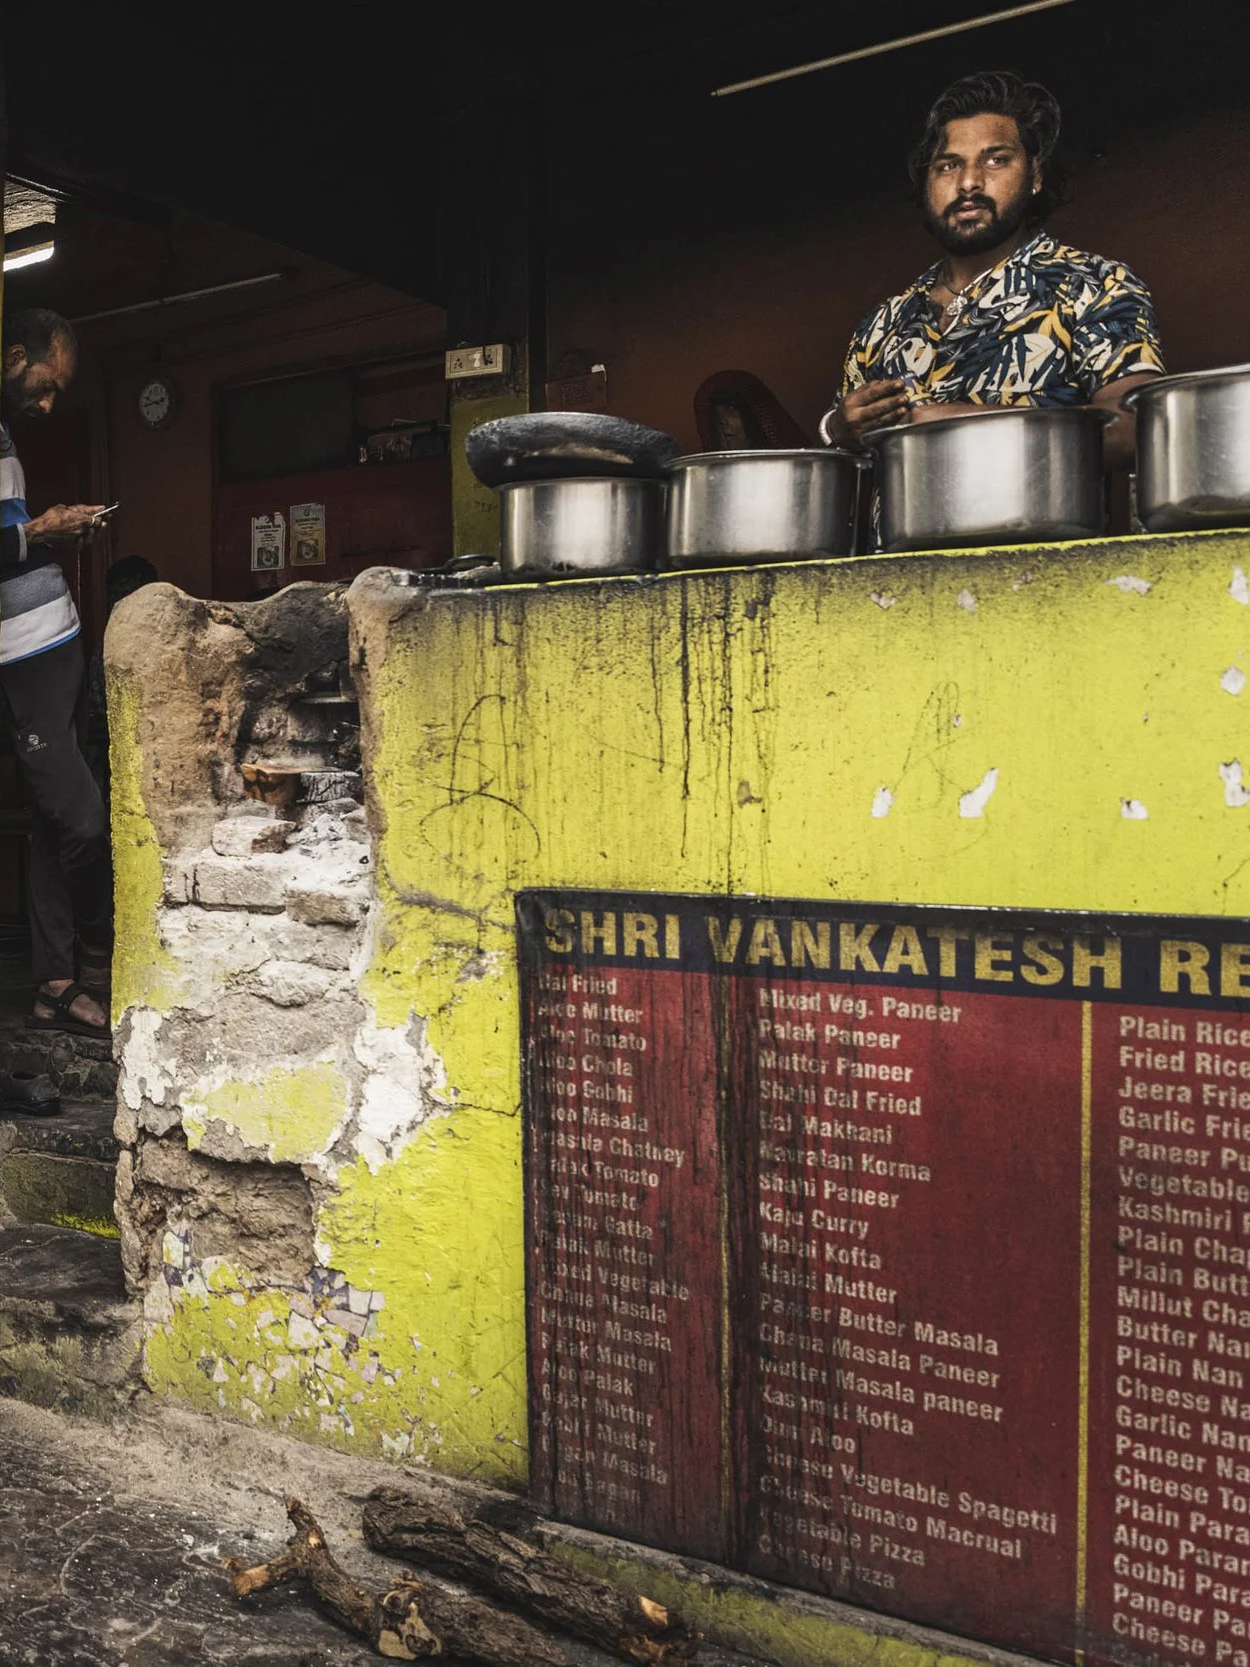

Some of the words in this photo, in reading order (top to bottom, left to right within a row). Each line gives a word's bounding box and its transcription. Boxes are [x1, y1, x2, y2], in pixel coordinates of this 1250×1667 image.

[544, 908, 680, 960] SHRI
[704, 914, 1123, 990] VANKATESH
[1159, 938, 1250, 999] RE
[572, 974, 617, 995] Fried
[582, 1001, 643, 1023] Mutter
[759, 987, 821, 1013] Mixed
[829, 993, 874, 1020] Veg.
[882, 995, 962, 1024] Paneer
[583, 1028, 647, 1051] Tomato
[759, 1018, 816, 1042] Palak
[825, 1024, 901, 1050] Paneer
[1119, 1015, 1186, 1042] Plain
[1196, 1020, 1250, 1048] Rice
[582, 1054, 633, 1077] Chola
[759, 1049, 830, 1075] Mutter
[836, 1057, 914, 1084] Paneer
[1119, 1045, 1185, 1073] Fried
[1195, 1051, 1250, 1079] Rice
[583, 1080, 633, 1103] Gobhi
[759, 1080, 816, 1105] Shahi
[824, 1087, 858, 1110] Dal
[866, 1090, 922, 1117] Fried
[1118, 1076, 1192, 1104] Jeera
[1202, 1083, 1250, 1111] Frie
[583, 1106, 648, 1133] Masala
[804, 1115, 893, 1145] Makhani
[1118, 1105, 1195, 1135] Garlic
[542, 1131, 603, 1153] asala
[610, 1137, 685, 1168] Chatney
[1118, 1135, 1211, 1168] Paneer
[1221, 1147, 1250, 1172] Pu
[594, 1161, 659, 1188] Tomato
[861, 1152, 931, 1183] Korma
[1118, 1165, 1250, 1204] Vegetable
[577, 1185, 639, 1211] Tomato
[759, 1171, 816, 1198] Shahi
[824, 1180, 900, 1209] Paneer
[605, 1216, 652, 1240] Gatta
[760, 1201, 804, 1228] Kaju
[812, 1209, 869, 1240] Curry
[1118, 1195, 1232, 1232] Kashmiri
[594, 1239, 655, 1266] Mutter
[760, 1232, 817, 1260] Malai
[825, 1241, 882, 1271] Kofta
[1118, 1225, 1183, 1256] Plain
[1194, 1236, 1250, 1272] Cha
[598, 1267, 690, 1301] Vegetable
[825, 1272, 897, 1304] Mutter
[1118, 1254, 1183, 1286] Plain
[1194, 1267, 1250, 1298] Butt
[602, 1294, 667, 1324] Masala
[1117, 1285, 1193, 1319] Millut
[1202, 1299, 1250, 1329] Cha
[605, 1320, 672, 1352] Masala
[839, 1306, 905, 1338] Butter
[914, 1320, 999, 1357] Masala
[1117, 1315, 1198, 1349] Butter
[597, 1344, 657, 1374] Mutter
[760, 1323, 823, 1353] Chana
[833, 1336, 911, 1371] Masala
[919, 1353, 1000, 1389] Paneer
[1117, 1345, 1182, 1378] Plain
[1192, 1357, 1244, 1390] Nan
[584, 1369, 634, 1397] Palak
[760, 1356, 828, 1385] Mutter
[836, 1369, 915, 1404] Masala
[923, 1389, 1003, 1423] paneer
[1116, 1374, 1210, 1413] Cheese
[1221, 1395, 1250, 1421] Na
[595, 1397, 654, 1428] Mutter
[856, 1405, 914, 1436] Kofta
[1116, 1404, 1192, 1441] Garlic
[1202, 1420, 1250, 1452] Nan
[597, 1423, 657, 1455] Mutter
[603, 1450, 668, 1485] Masala
[1116, 1433, 1207, 1473] Paneer
[1216, 1455, 1250, 1484] Na
[840, 1462, 950, 1509] Vegetable
[958, 1491, 1057, 1535] Spagetti
[1114, 1464, 1209, 1505] Cheese
[1218, 1486, 1250, 1514] To
[840, 1495, 918, 1533] Tomato
[1115, 1494, 1180, 1528] Plain
[1190, 1511, 1250, 1546] Para
[869, 1534, 925, 1567] Pizza
[1114, 1524, 1169, 1556] Aloo
[1113, 1553, 1186, 1591] Gobhi
[1113, 1582, 1203, 1625] Paneer
[1112, 1612, 1206, 1656] Cheese
[1216, 1639, 1250, 1667] Pa
